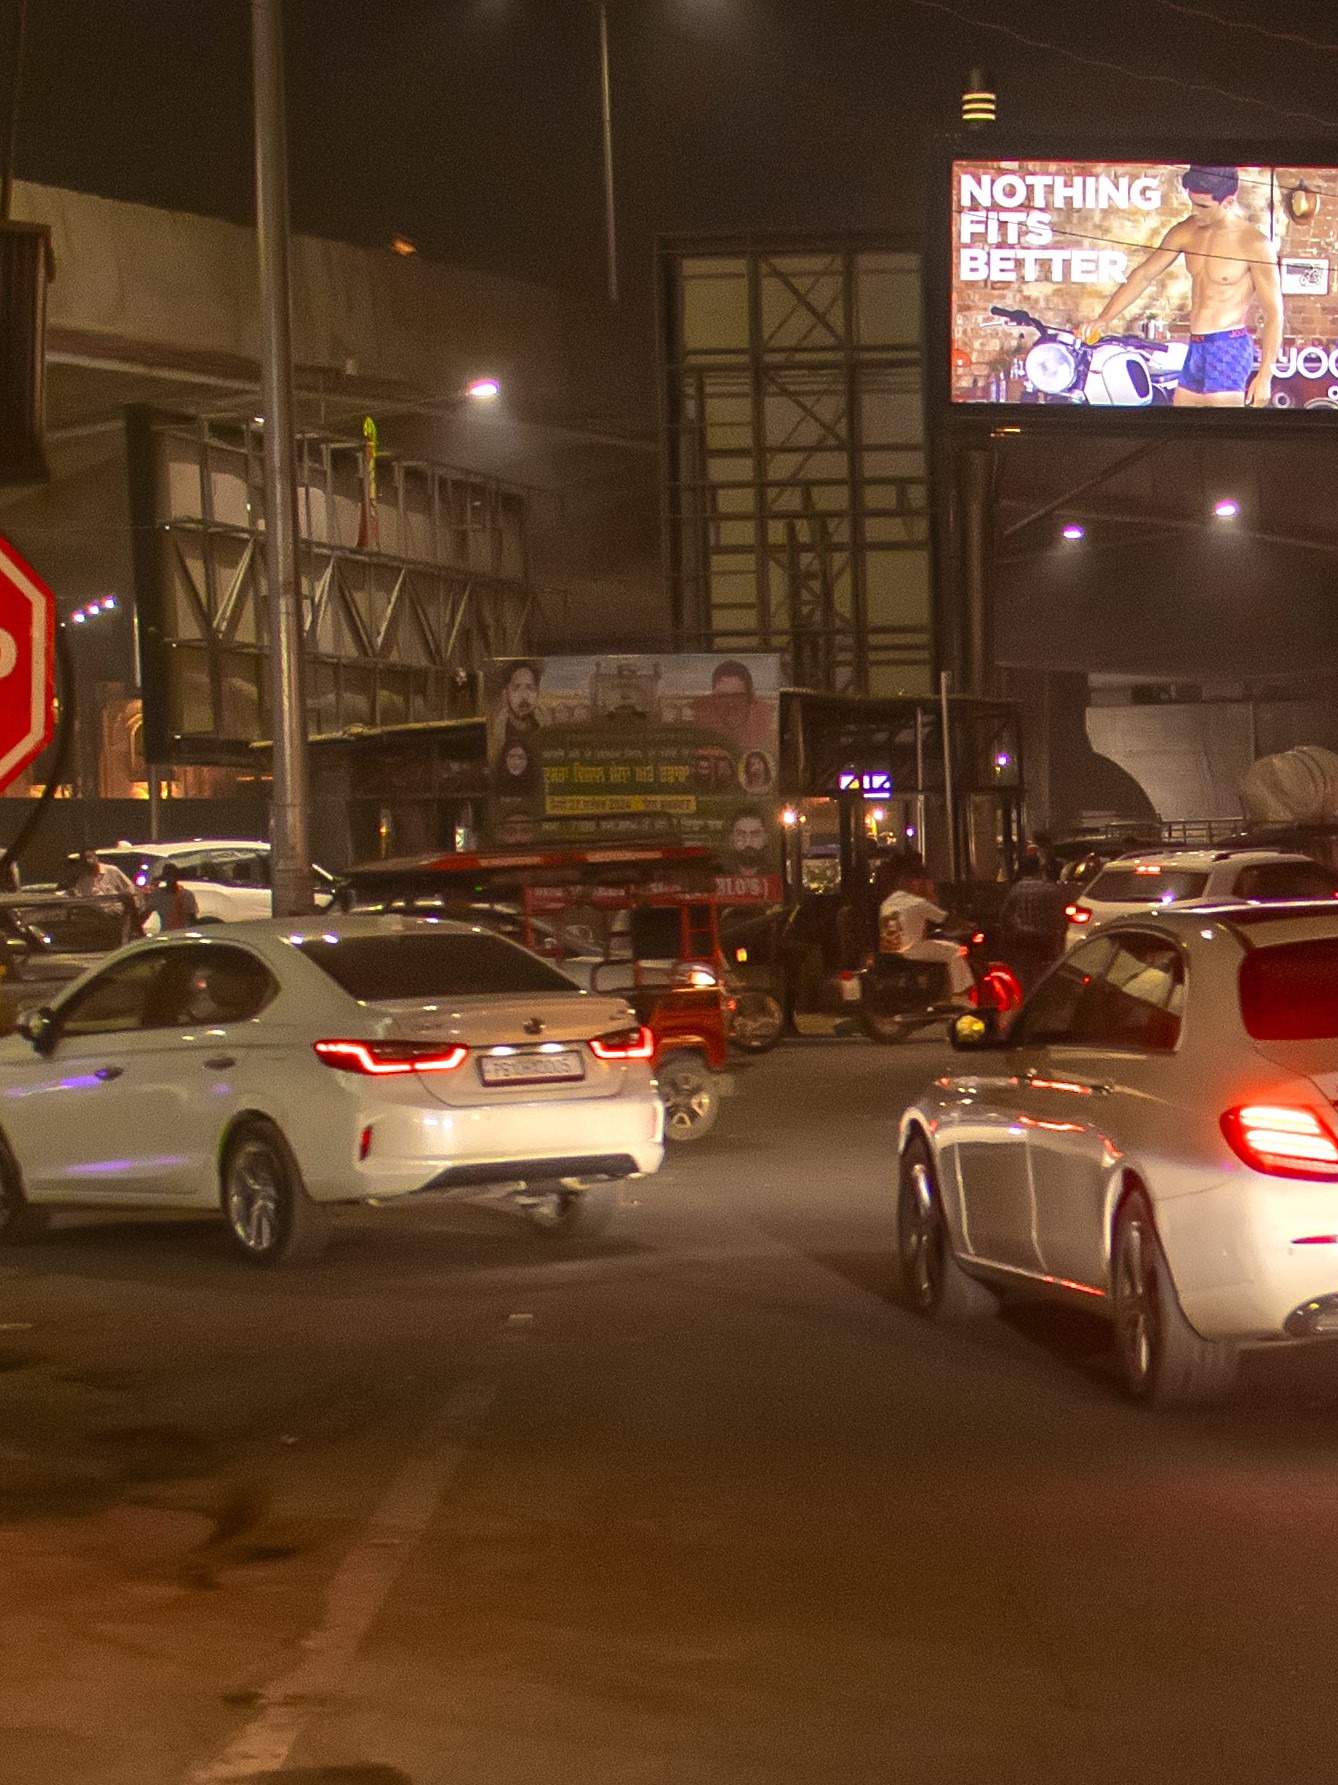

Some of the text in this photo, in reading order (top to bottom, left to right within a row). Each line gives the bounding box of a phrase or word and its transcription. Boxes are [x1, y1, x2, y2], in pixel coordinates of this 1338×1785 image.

[960, 174, 1161, 210] NOTHING
[960, 211, 1053, 246] FITS
[960, 248, 1128, 283] BETTER
